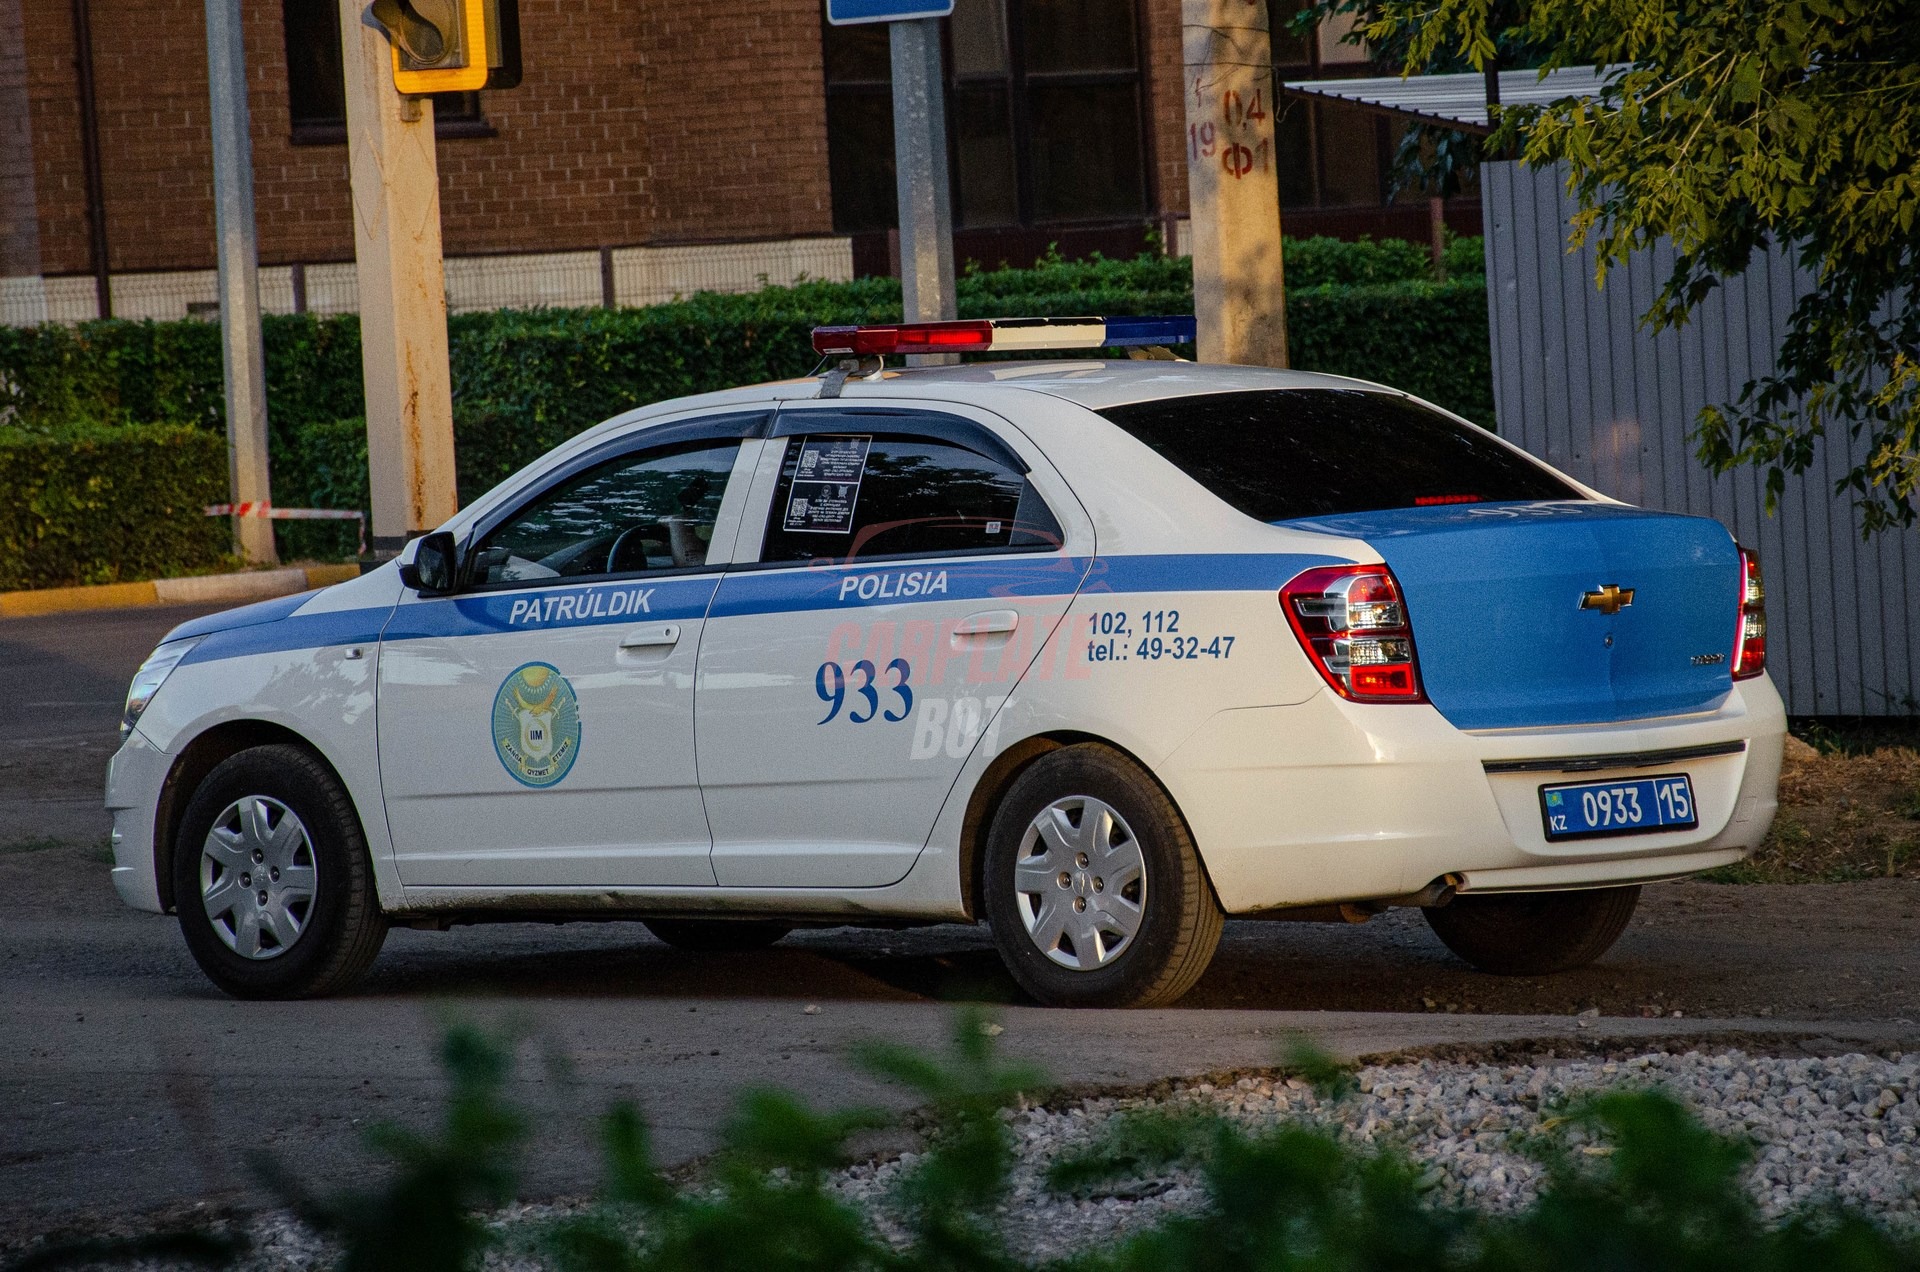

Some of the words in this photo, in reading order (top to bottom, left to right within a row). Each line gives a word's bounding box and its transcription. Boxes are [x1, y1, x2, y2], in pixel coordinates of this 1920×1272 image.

[1189, 121, 1216, 161] 19
[839, 571, 947, 600] POLISIA
[508, 588, 656, 625] PATRÚLDIK
[1088, 612, 1132, 637] 102,
[1142, 611, 1179, 633] 112
[1087, 642, 1129, 662] tel.:
[1136, 636, 1236, 660] 49-32-47
[815, 658, 913, 725] 933
[1582, 787, 1642, 827] 0933
[1660, 782, 1689, 819] 15
[1550, 815, 1568, 831] KZ
